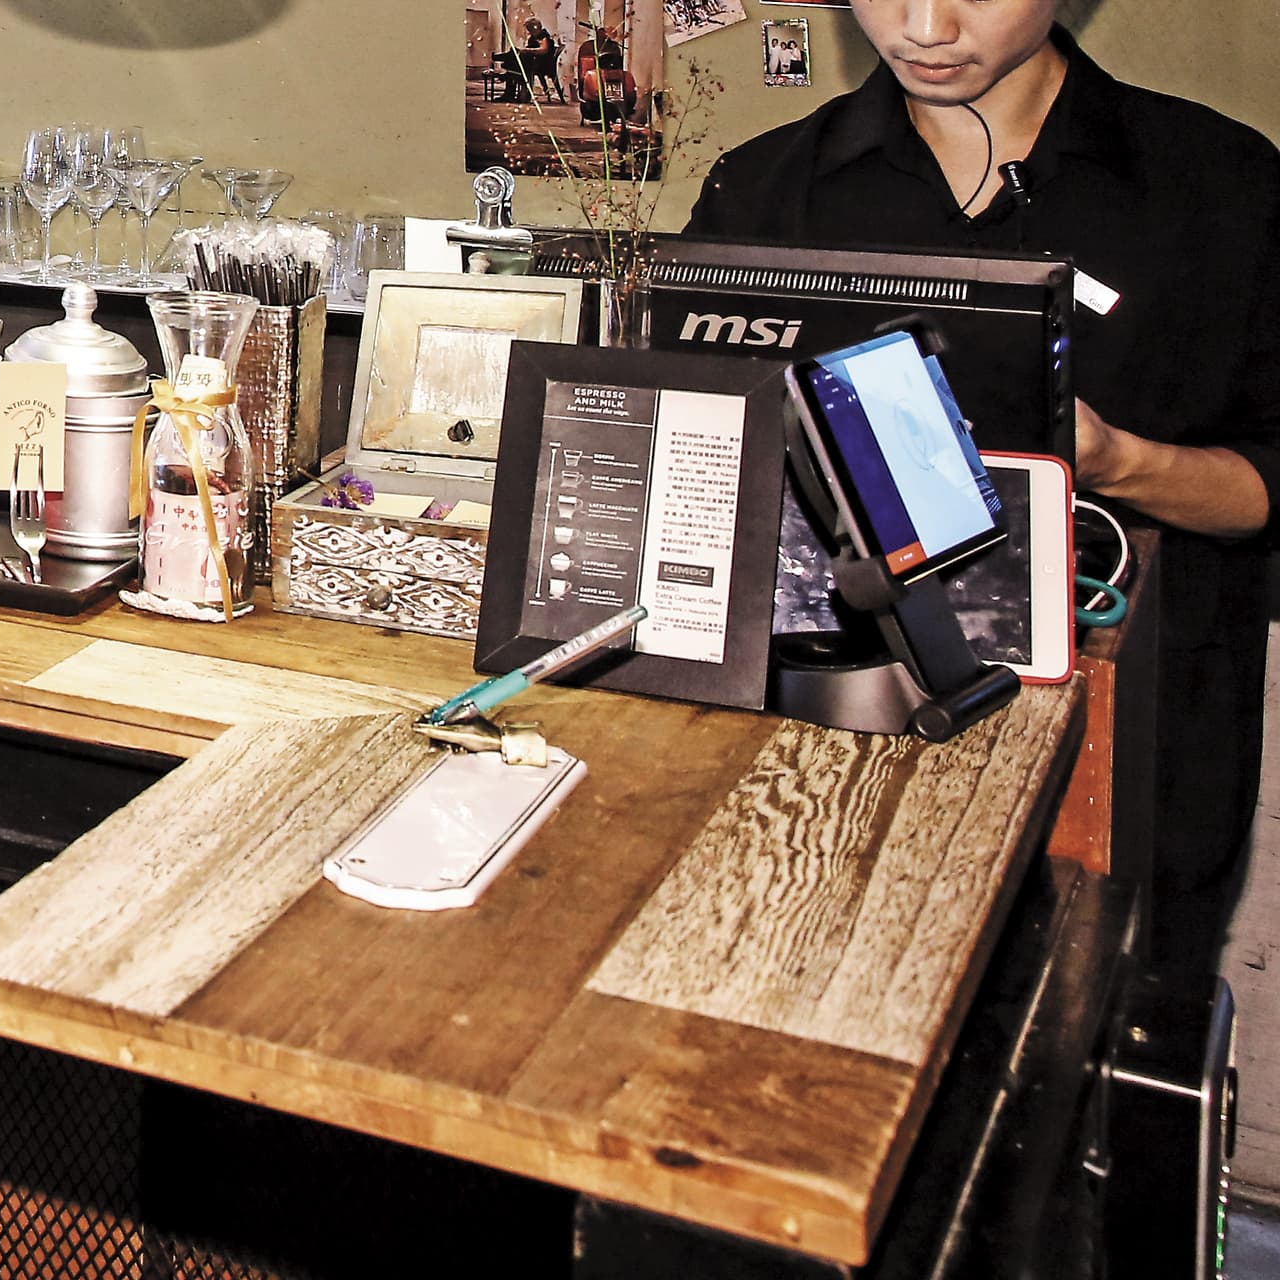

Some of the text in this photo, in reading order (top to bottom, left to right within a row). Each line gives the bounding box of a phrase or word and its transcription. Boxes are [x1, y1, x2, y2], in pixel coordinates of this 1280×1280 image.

[679, 312, 803, 348] msi
[574, 387, 626, 400] ESPRESSO
[3, 399, 56, 419] ANTICO FORNO
[574, 397, 624, 409] AND MILK
[663, 564, 709, 577] KIMBO
